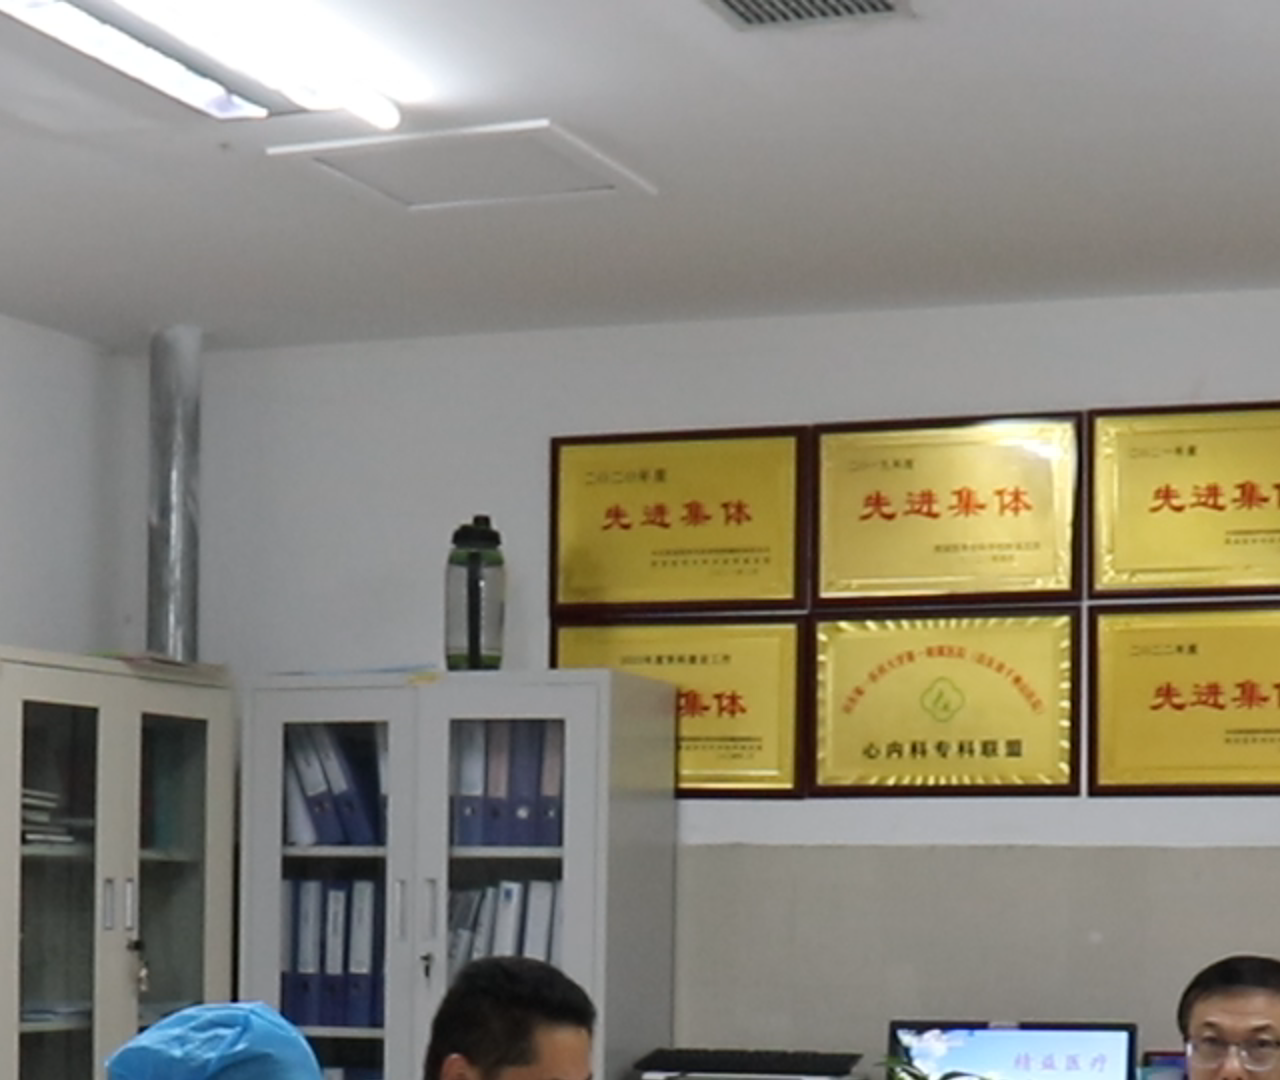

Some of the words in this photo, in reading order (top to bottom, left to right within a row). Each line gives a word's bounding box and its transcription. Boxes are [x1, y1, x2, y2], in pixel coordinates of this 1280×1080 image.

[601, 499, 753, 531] 先进集体
[858, 486, 1034, 522] 先进集体
[862, 739, 1023, 760] 心内科专科联盟
